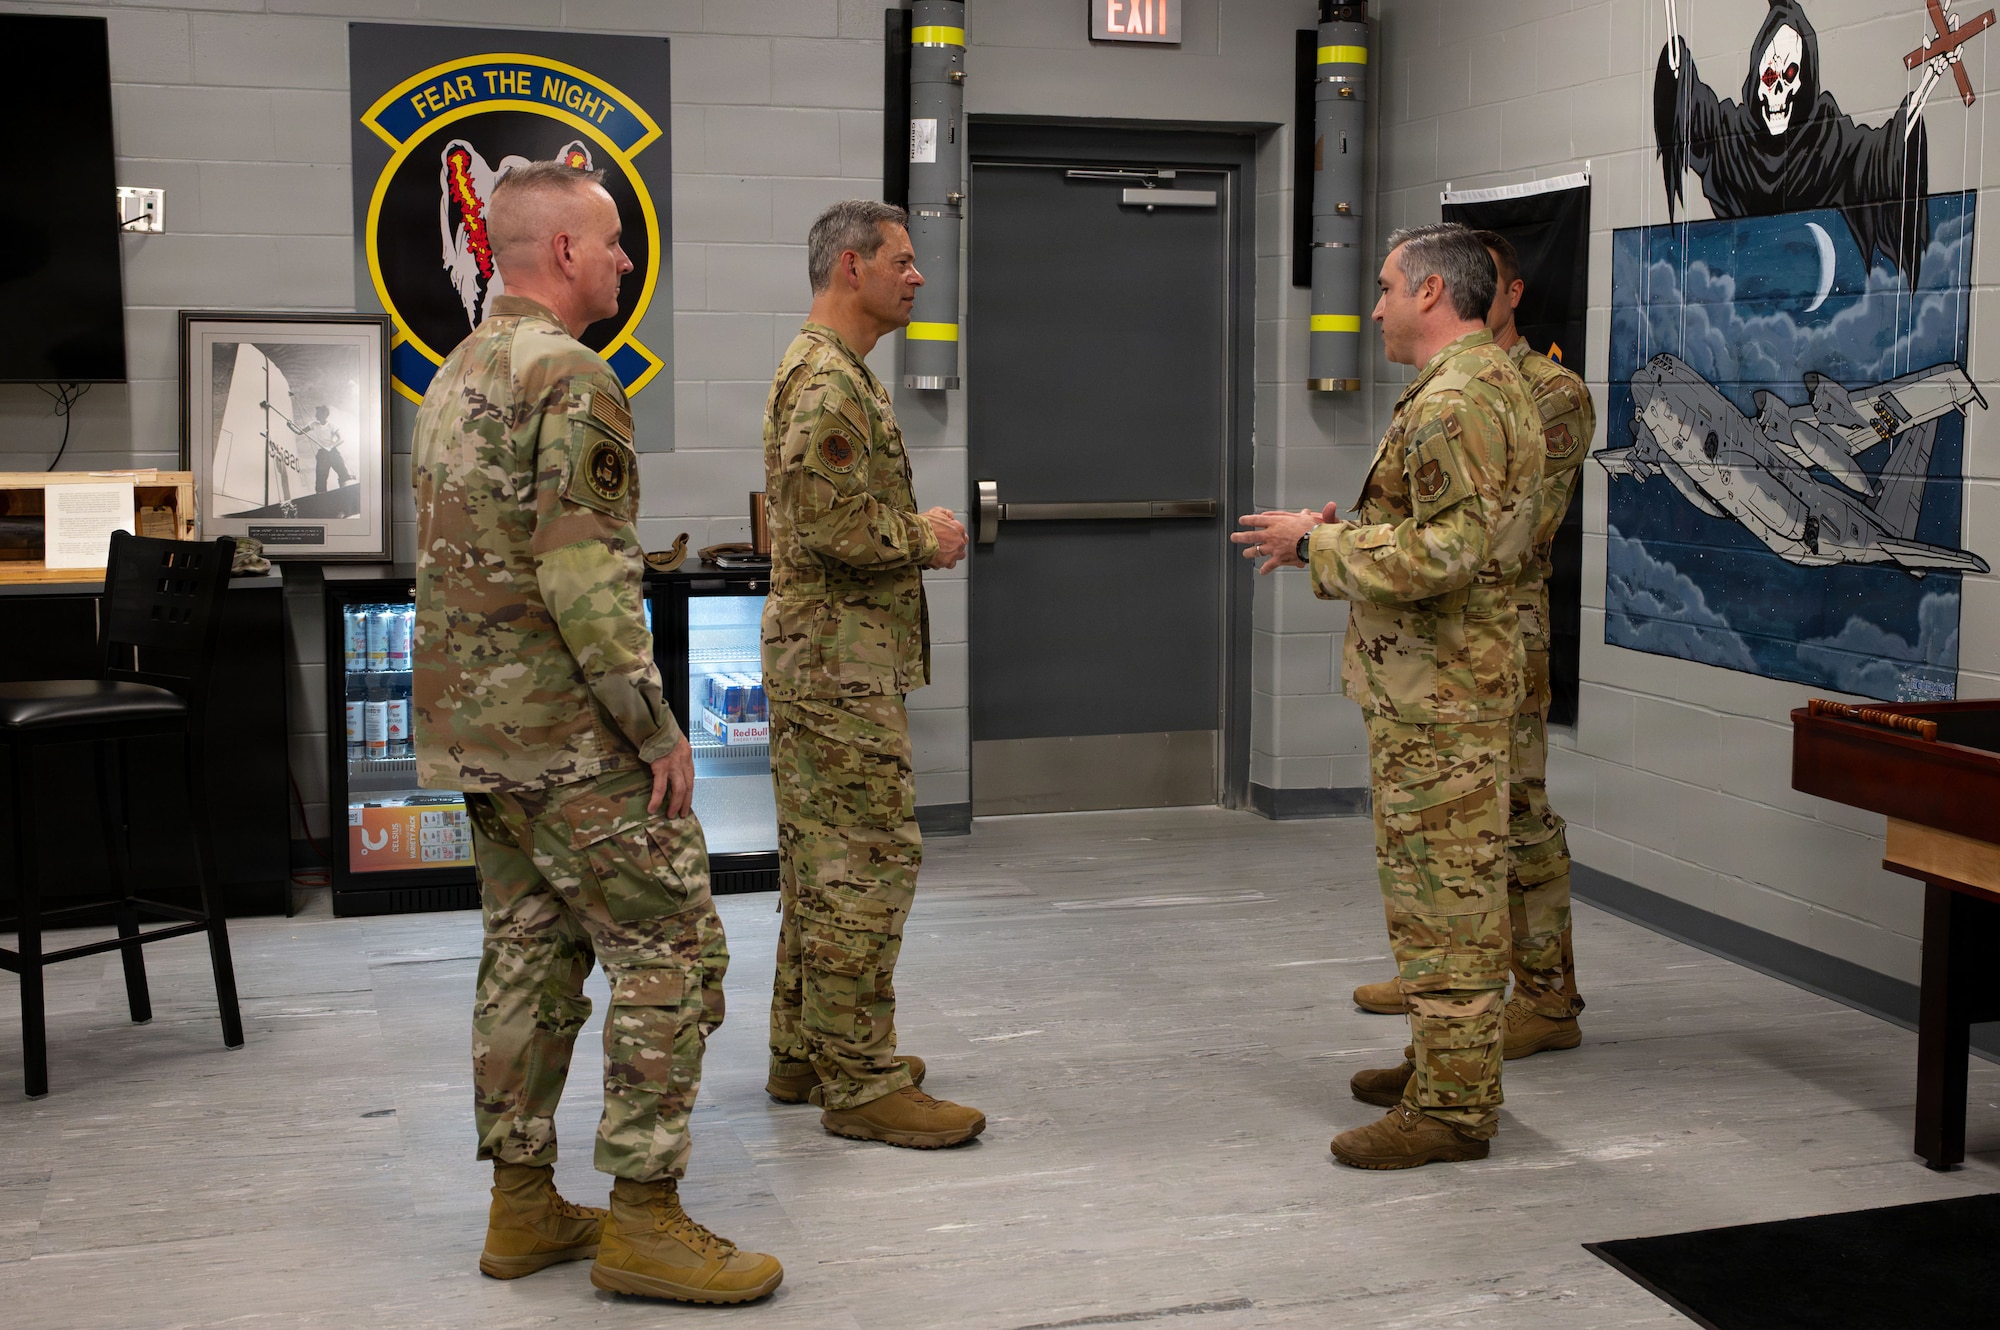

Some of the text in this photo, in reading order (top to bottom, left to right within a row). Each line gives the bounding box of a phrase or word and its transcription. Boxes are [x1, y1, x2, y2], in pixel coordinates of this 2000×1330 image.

[410, 70, 615, 124] FEAR THE NIGHT
[733, 727, 768, 737] Red Bull
[391, 822, 400, 853] CELSIUS
[409, 815, 417, 859] VARIETY PACK
